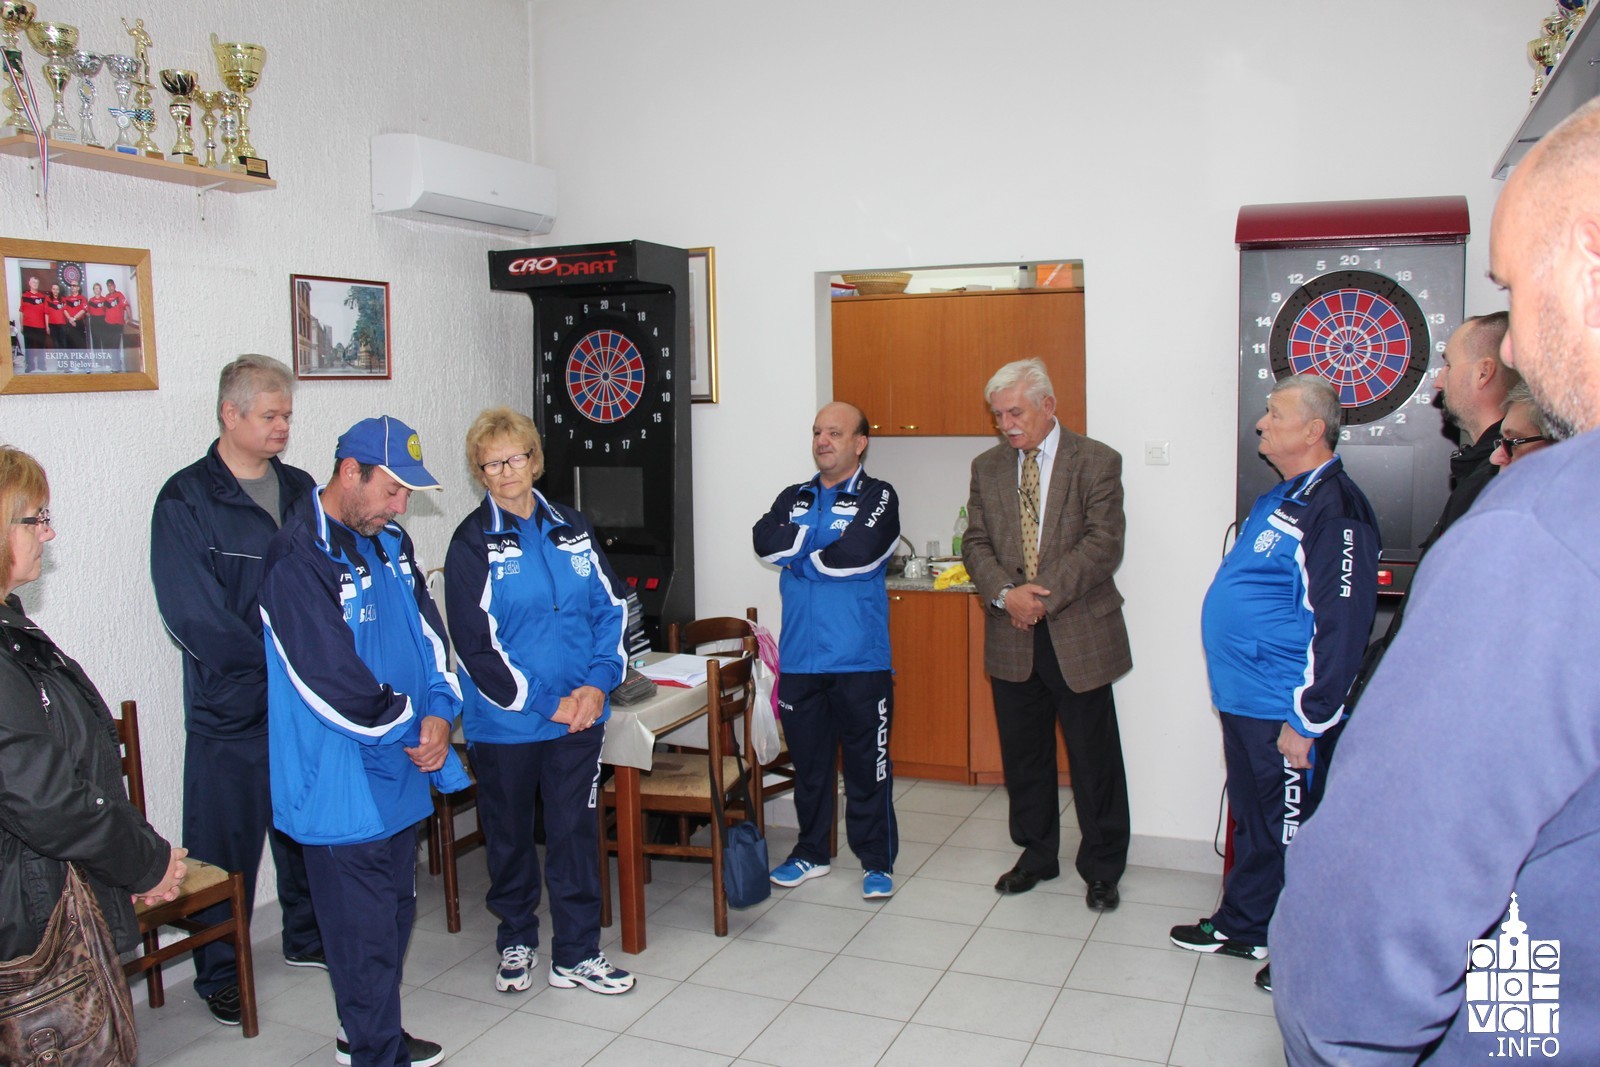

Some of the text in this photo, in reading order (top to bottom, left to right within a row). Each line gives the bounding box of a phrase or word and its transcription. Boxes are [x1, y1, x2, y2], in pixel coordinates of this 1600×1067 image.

[1316, 260, 1326, 271] 5
[1339, 254, 1360, 266] 20
[1374, 258, 1381, 270] 1
[1287, 273, 1304, 285] 12
[1395, 270, 1412, 282] 18
[1271, 292, 1282, 303] 9
[1417, 289, 1429, 300] 4
[583, 304, 589, 314] 5
[600, 299, 609, 310] 20
[565, 315, 574, 325] 12
[637, 311, 646, 322] 18
[1255, 316, 1272, 328] 14
[1426, 313, 1445, 326] 13
[553, 331, 559, 341] 9
[652, 327, 658, 337] 4
[661, 347, 670, 358] 13
[1252, 343, 1266, 354] 11
[1435, 341, 1447, 353] 6
[45, 351, 112, 360] EKIPA PIKADISTA
[544, 351, 553, 361] 14
[57, 360, 69, 368] US
[665, 369, 672, 380] 6
[1257, 368, 1269, 380] 8
[546, 394, 552, 404] 8
[661, 392, 671, 402] 10
[1414, 393, 1431, 405] 15
[553, 413, 563, 424] 16
[652, 412, 662, 423] 15
[1395, 412, 1406, 424] 2
[569, 429, 574, 439] 7
[641, 429, 646, 439] 2
[1340, 429, 1351, 441] 3
[1368, 425, 1385, 437] 17
[584, 439, 593, 450] 19
[605, 442, 610, 453] 3
[621, 439, 631, 450] 17
[1340, 528, 1354, 598] GIVOVA
[876, 697, 888, 783] GIVOVA
